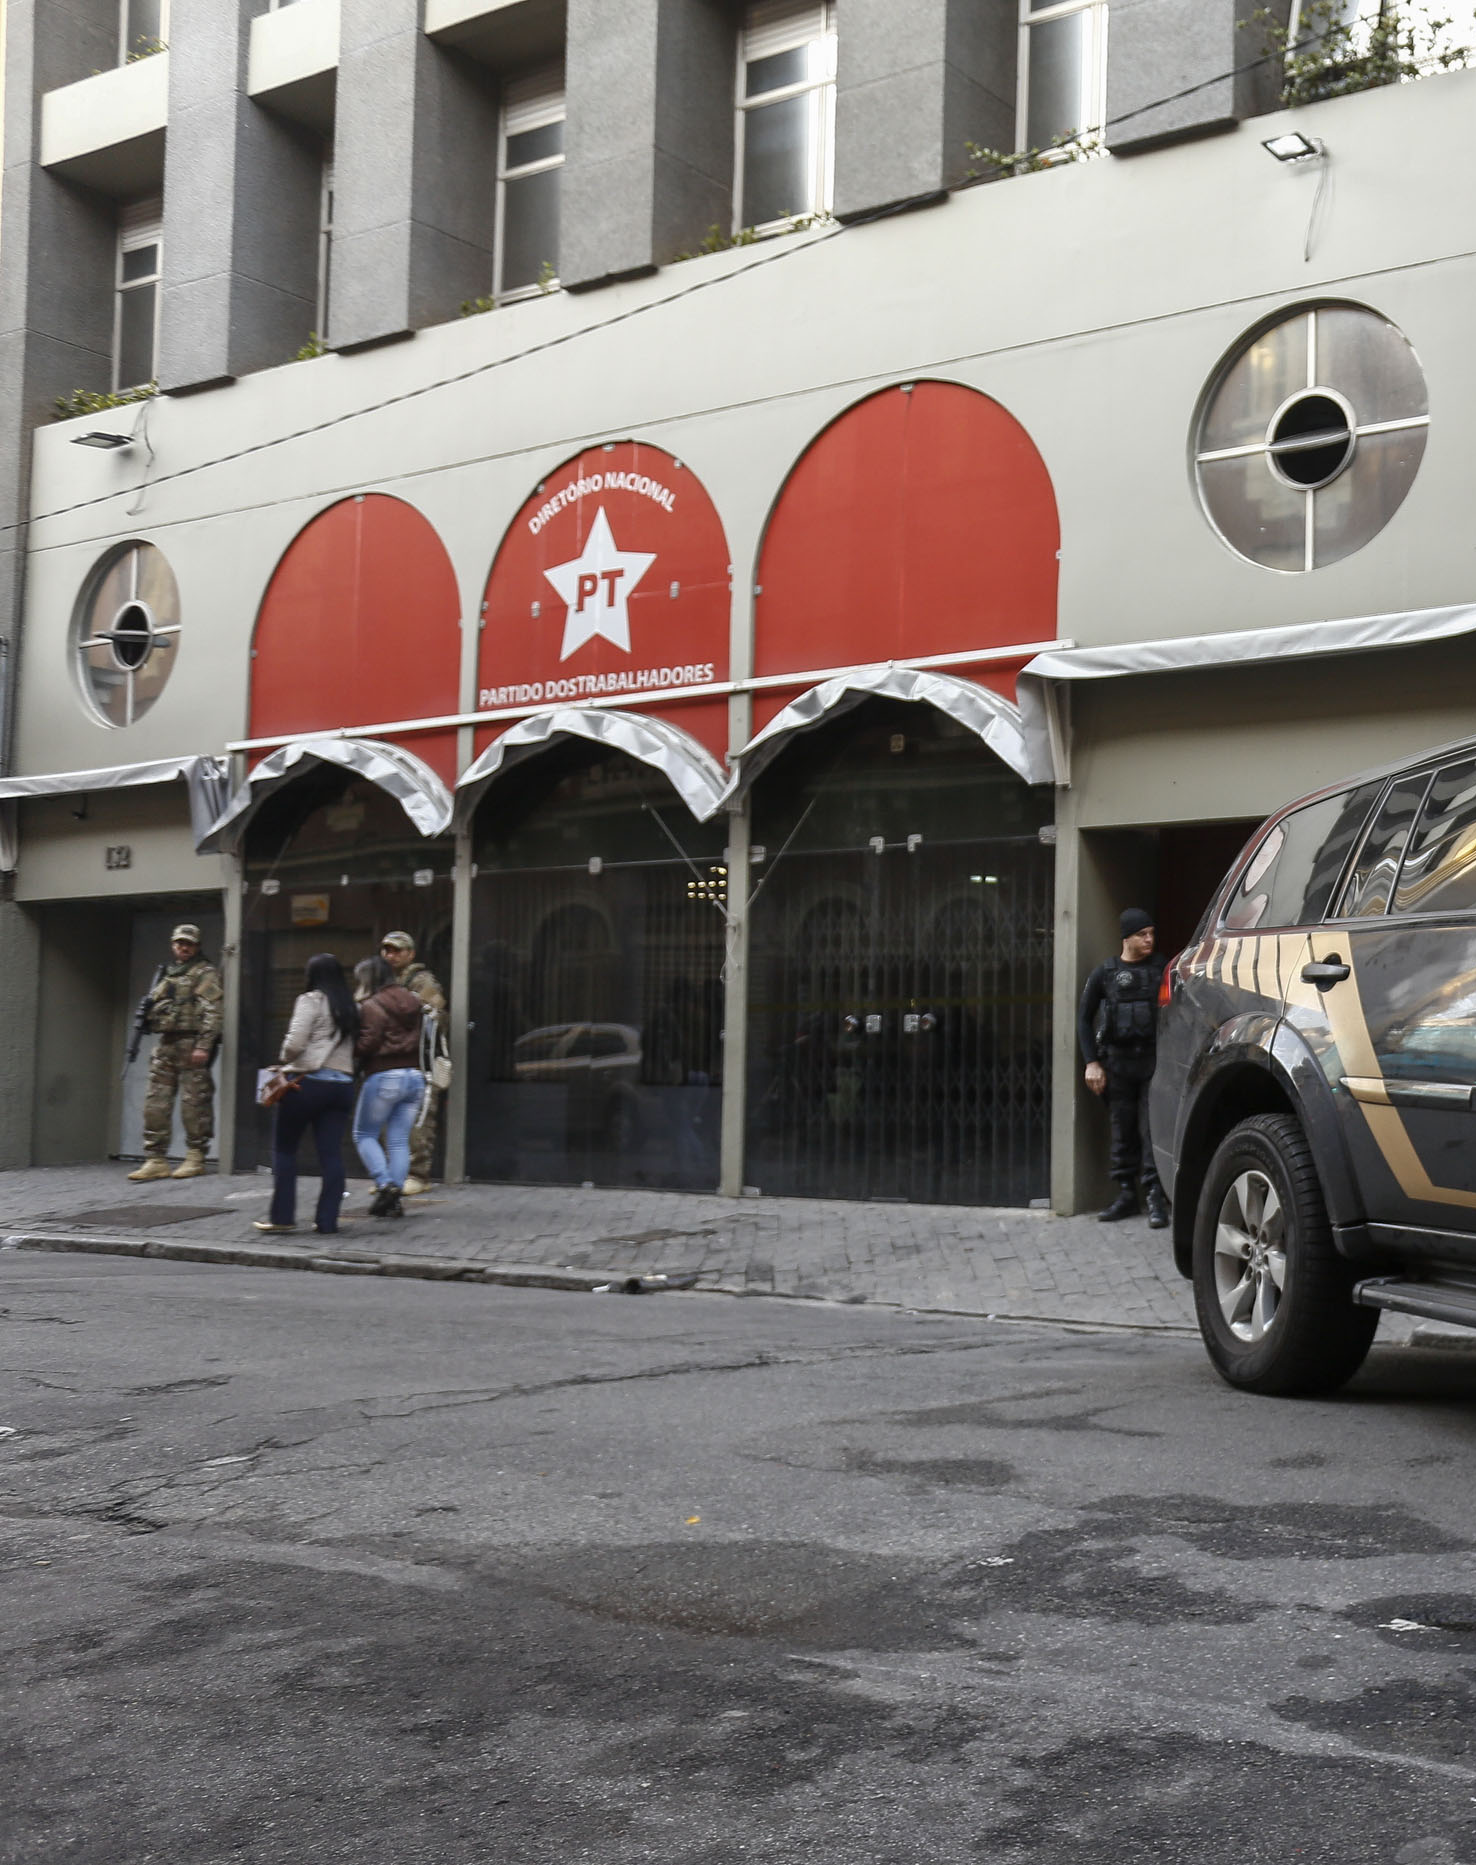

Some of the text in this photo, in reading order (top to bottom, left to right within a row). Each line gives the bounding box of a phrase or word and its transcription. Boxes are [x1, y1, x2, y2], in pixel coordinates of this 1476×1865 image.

[528, 471, 676, 535] DIRETÓRIO NACIONAL
[575, 567, 625, 614] PT
[479, 683, 543, 707] PARTIDO
